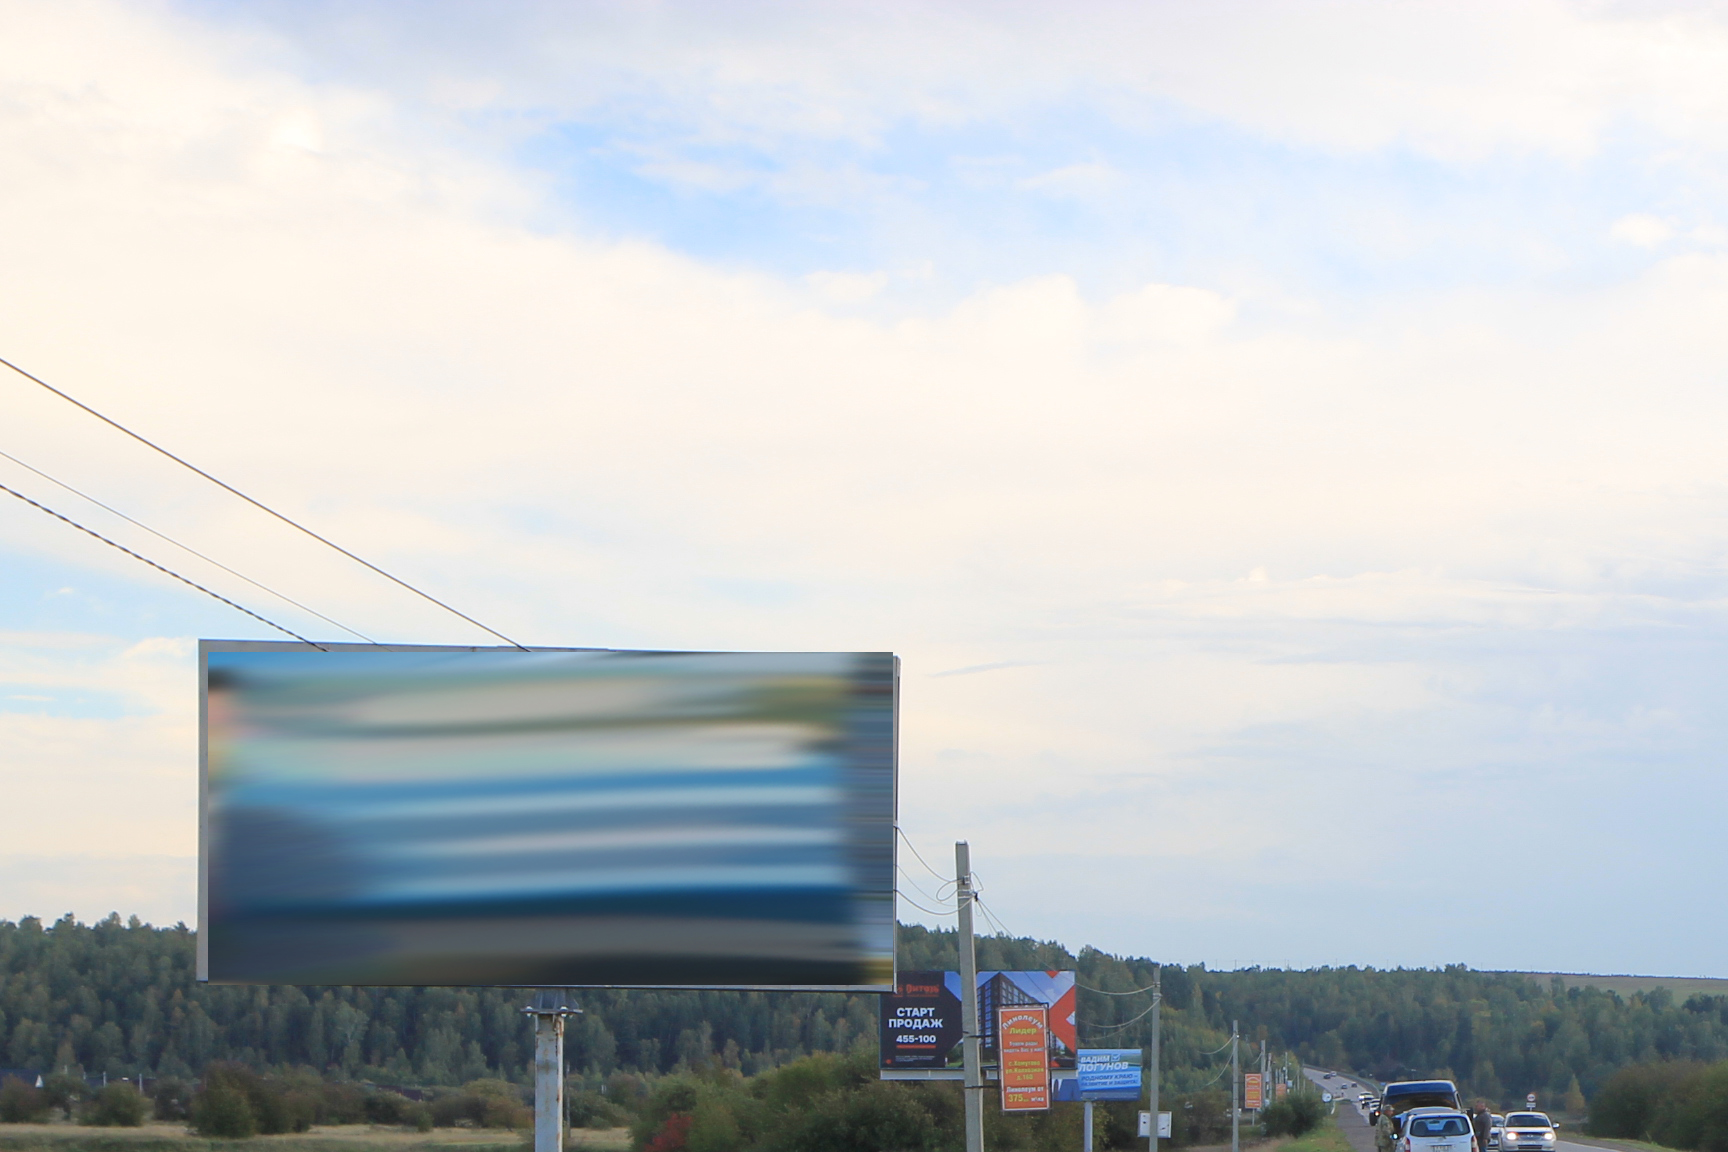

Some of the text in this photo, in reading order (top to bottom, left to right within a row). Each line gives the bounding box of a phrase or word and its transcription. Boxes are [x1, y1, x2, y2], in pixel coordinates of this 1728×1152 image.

[896, 1008, 935, 1017] СТАРТ
[888, 1019, 943, 1029] ПРОДАЖ
[1002, 1014, 1043, 1030] Линолеум
[1009, 1027, 1037, 1035] Лидер
[896, 1035, 936, 1043] 455-100
[1080, 1055, 1110, 1063] ВАДИМ
[1078, 1062, 1129, 1072] ЛОГУНОВ
